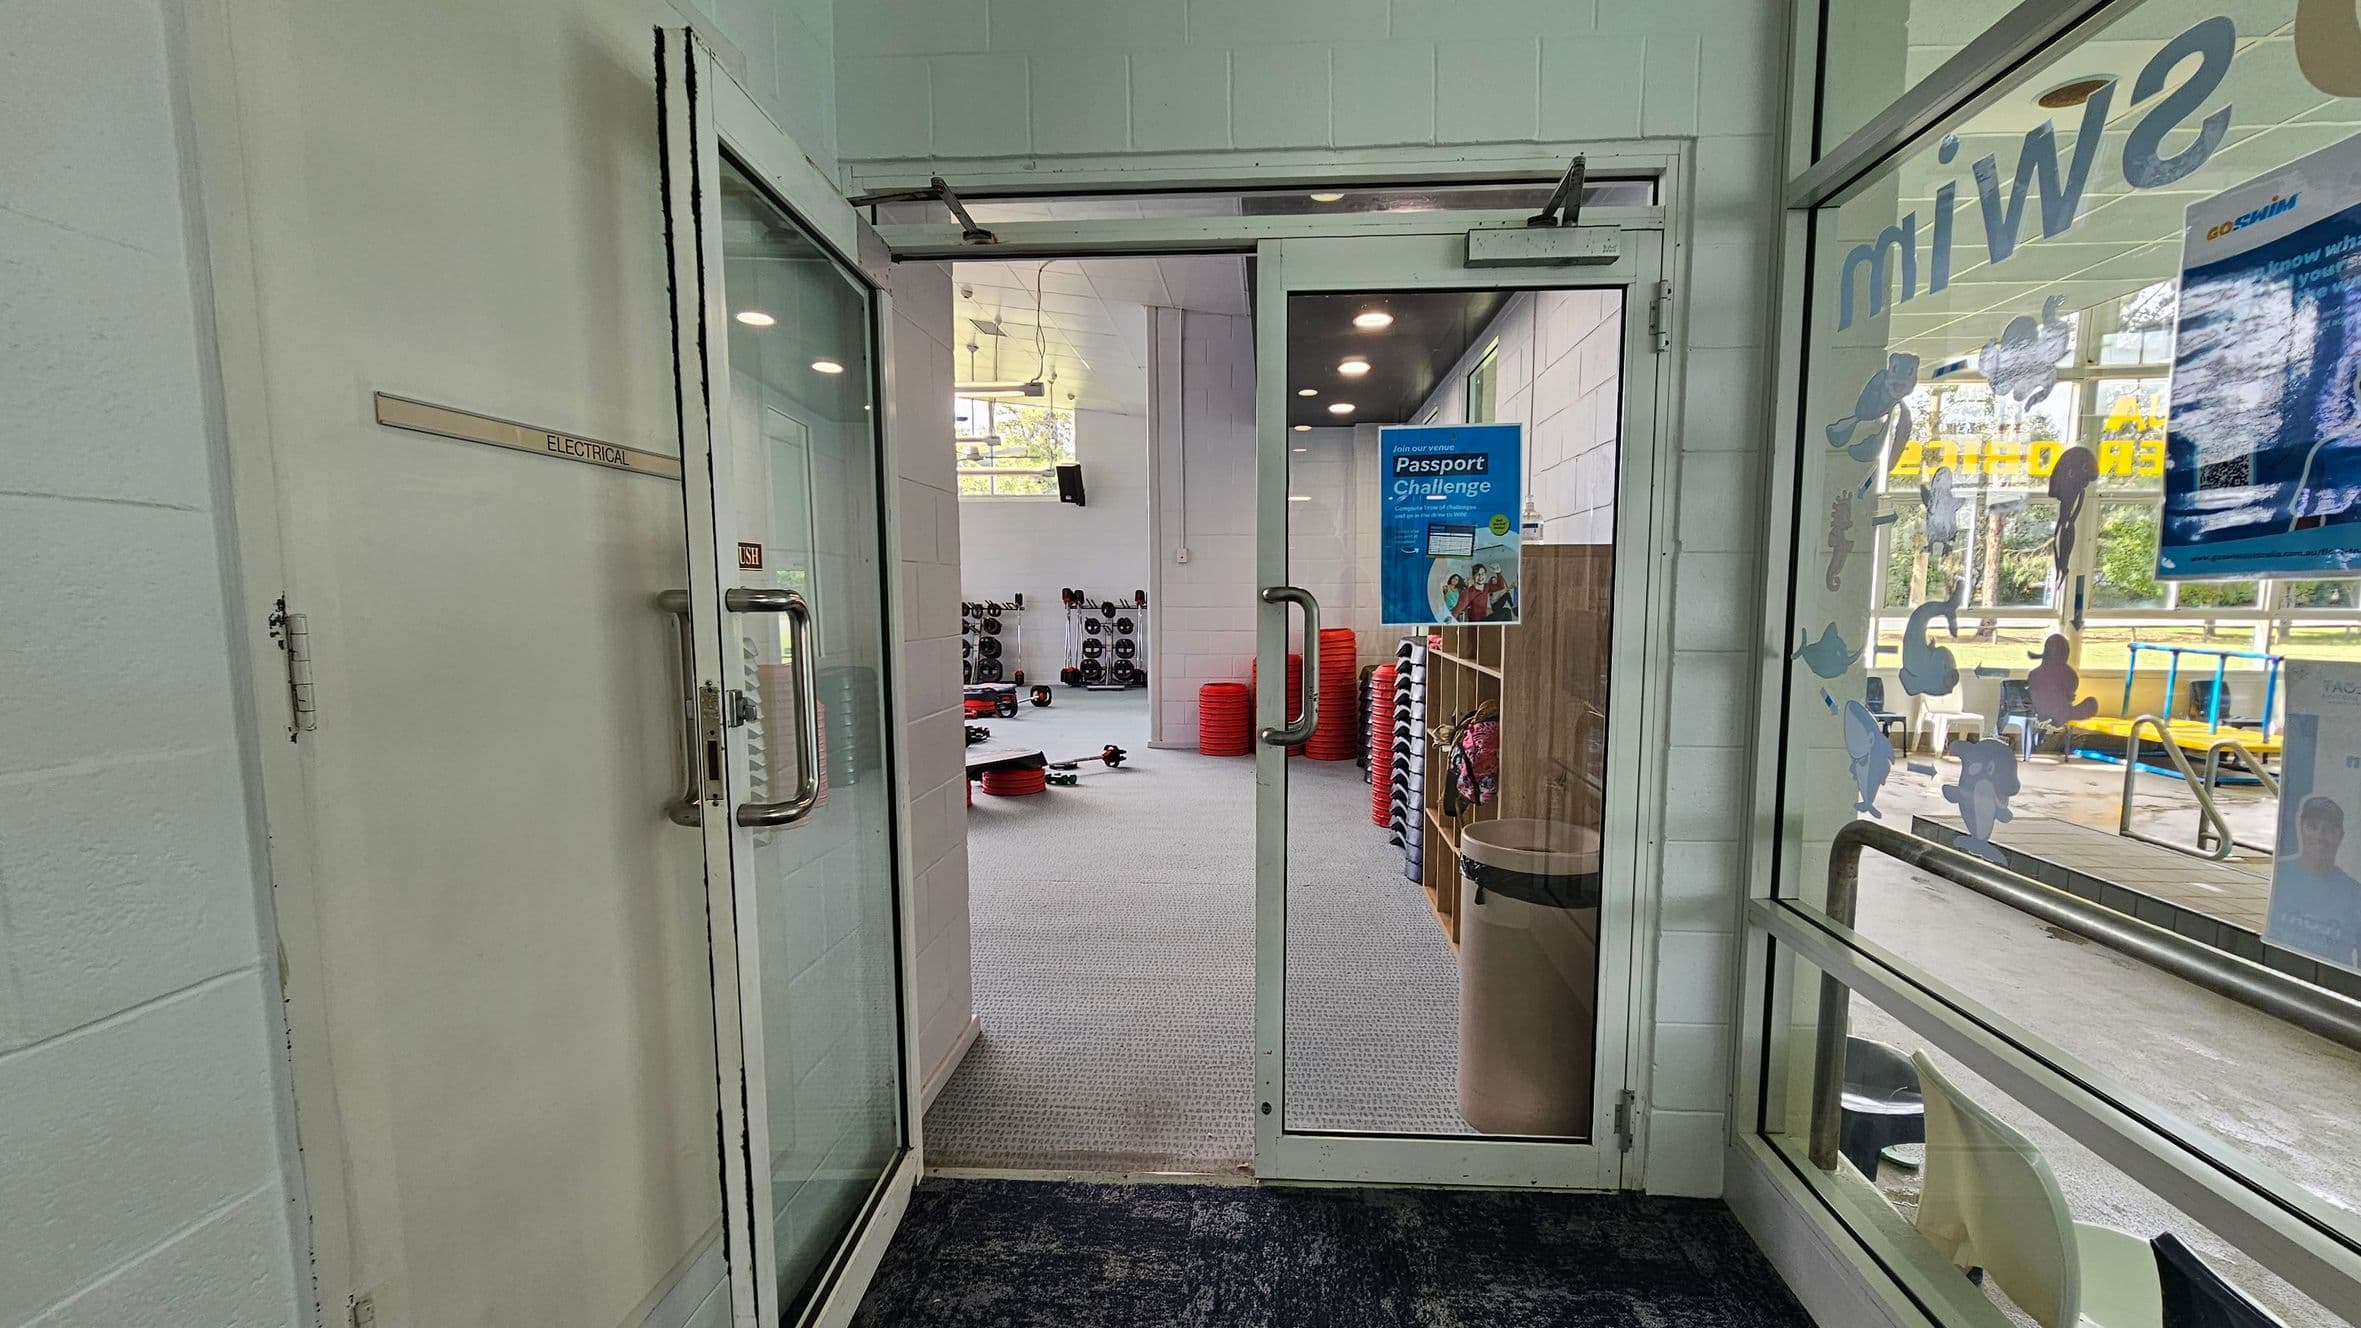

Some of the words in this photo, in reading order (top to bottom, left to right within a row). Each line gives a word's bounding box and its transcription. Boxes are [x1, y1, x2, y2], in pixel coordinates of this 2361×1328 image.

[2267, 247, 2321, 273] know
[2300, 255, 2361, 287] yours
[546, 434, 630, 467] ELECTRICAL
[1392, 444, 1410, 453] Join
[1396, 456, 1485, 475] Passport
[1393, 479, 1491, 498] Challenge
[738, 546, 760, 566] USH
